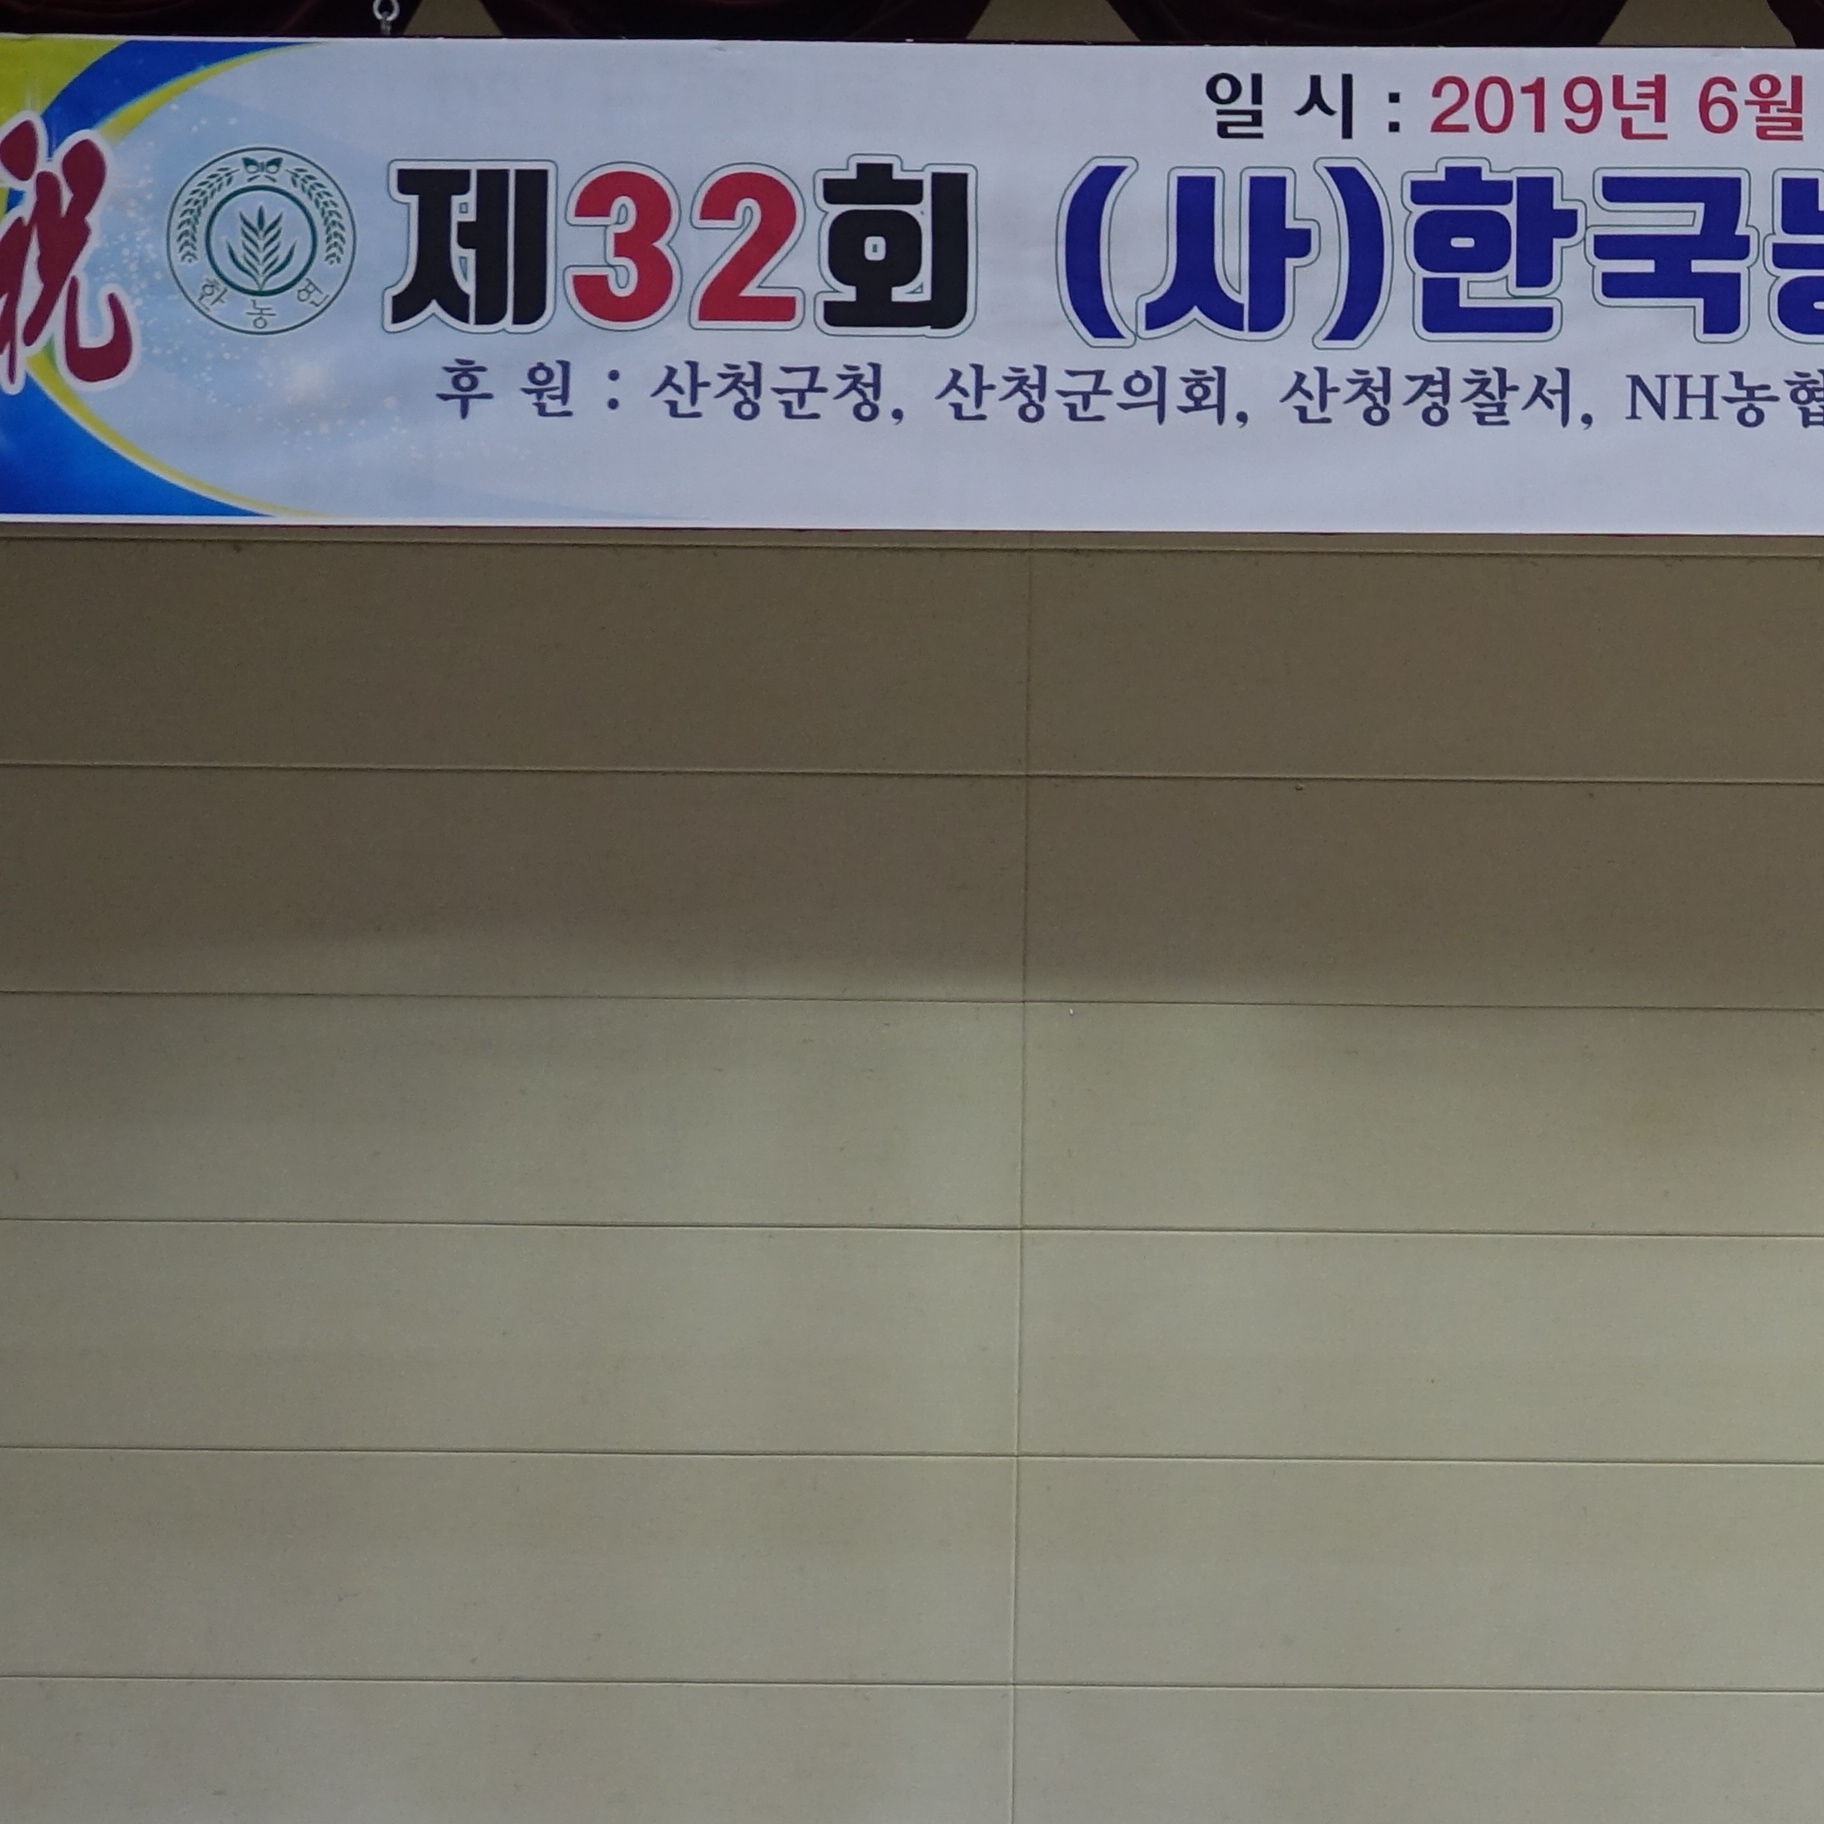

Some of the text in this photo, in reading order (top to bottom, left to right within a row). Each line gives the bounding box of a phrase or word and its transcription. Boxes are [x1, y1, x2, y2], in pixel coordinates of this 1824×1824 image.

[1430, 74, 1669, 143] 2019년
[1697, 74, 1805, 143] 6월
[391, 162, 975, 331] 제32회
[196, 276, 329, 332] 한농연
[648, 360, 907, 431] 산청군청,
[935, 361, 1251, 431] 산청군의회,
[1279, 362, 1596, 434] 산청경찰서,
